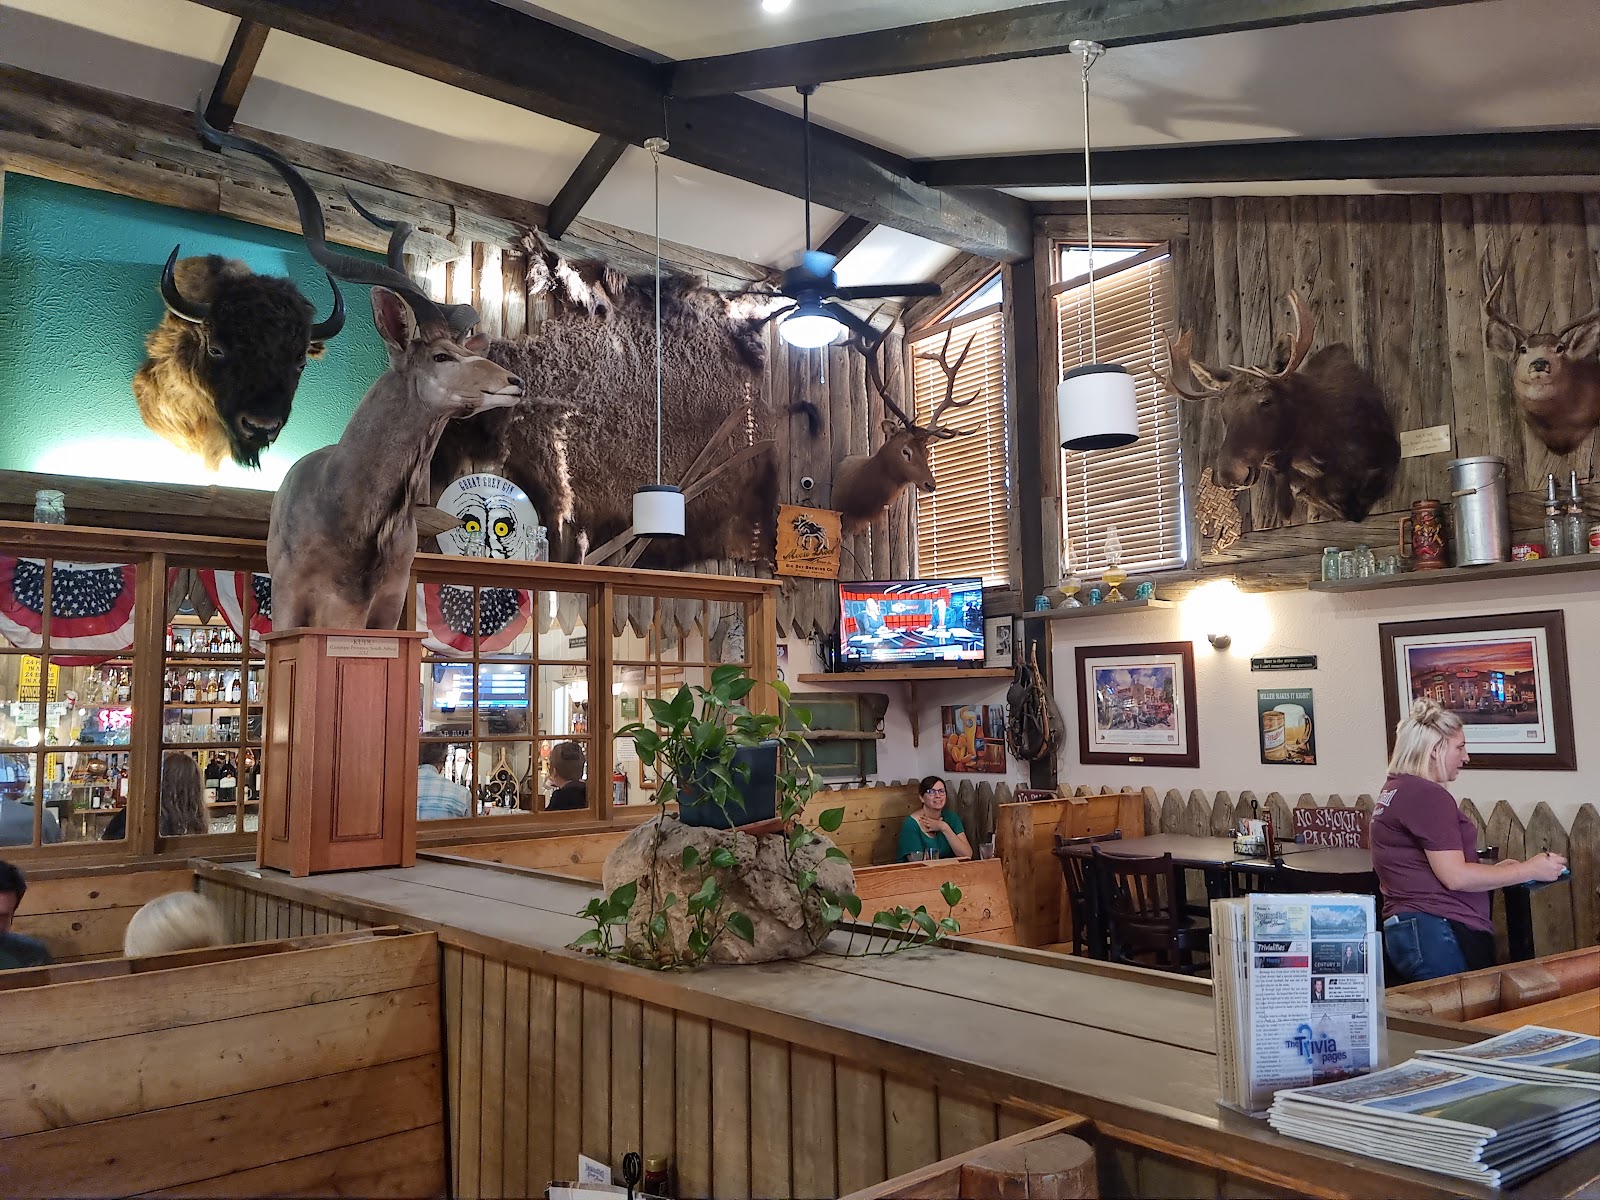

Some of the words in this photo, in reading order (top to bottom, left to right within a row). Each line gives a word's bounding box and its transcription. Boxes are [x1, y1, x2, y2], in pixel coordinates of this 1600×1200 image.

[458, 477, 481, 491] GREAT
[483, 476, 501, 489] GREY
[502, 481, 515, 494] GIN
[1296, 808, 1312, 827] NO
[1315, 809, 1363, 832] SMOKIN'
[1303, 830, 1361, 848] PARDNER
[1257, 943, 1286, 952] Trivialities
[1286, 1040, 1298, 1049] The
[1294, 1033, 1337, 1056] Trivia
[1322, 1051, 1347, 1065] pages
